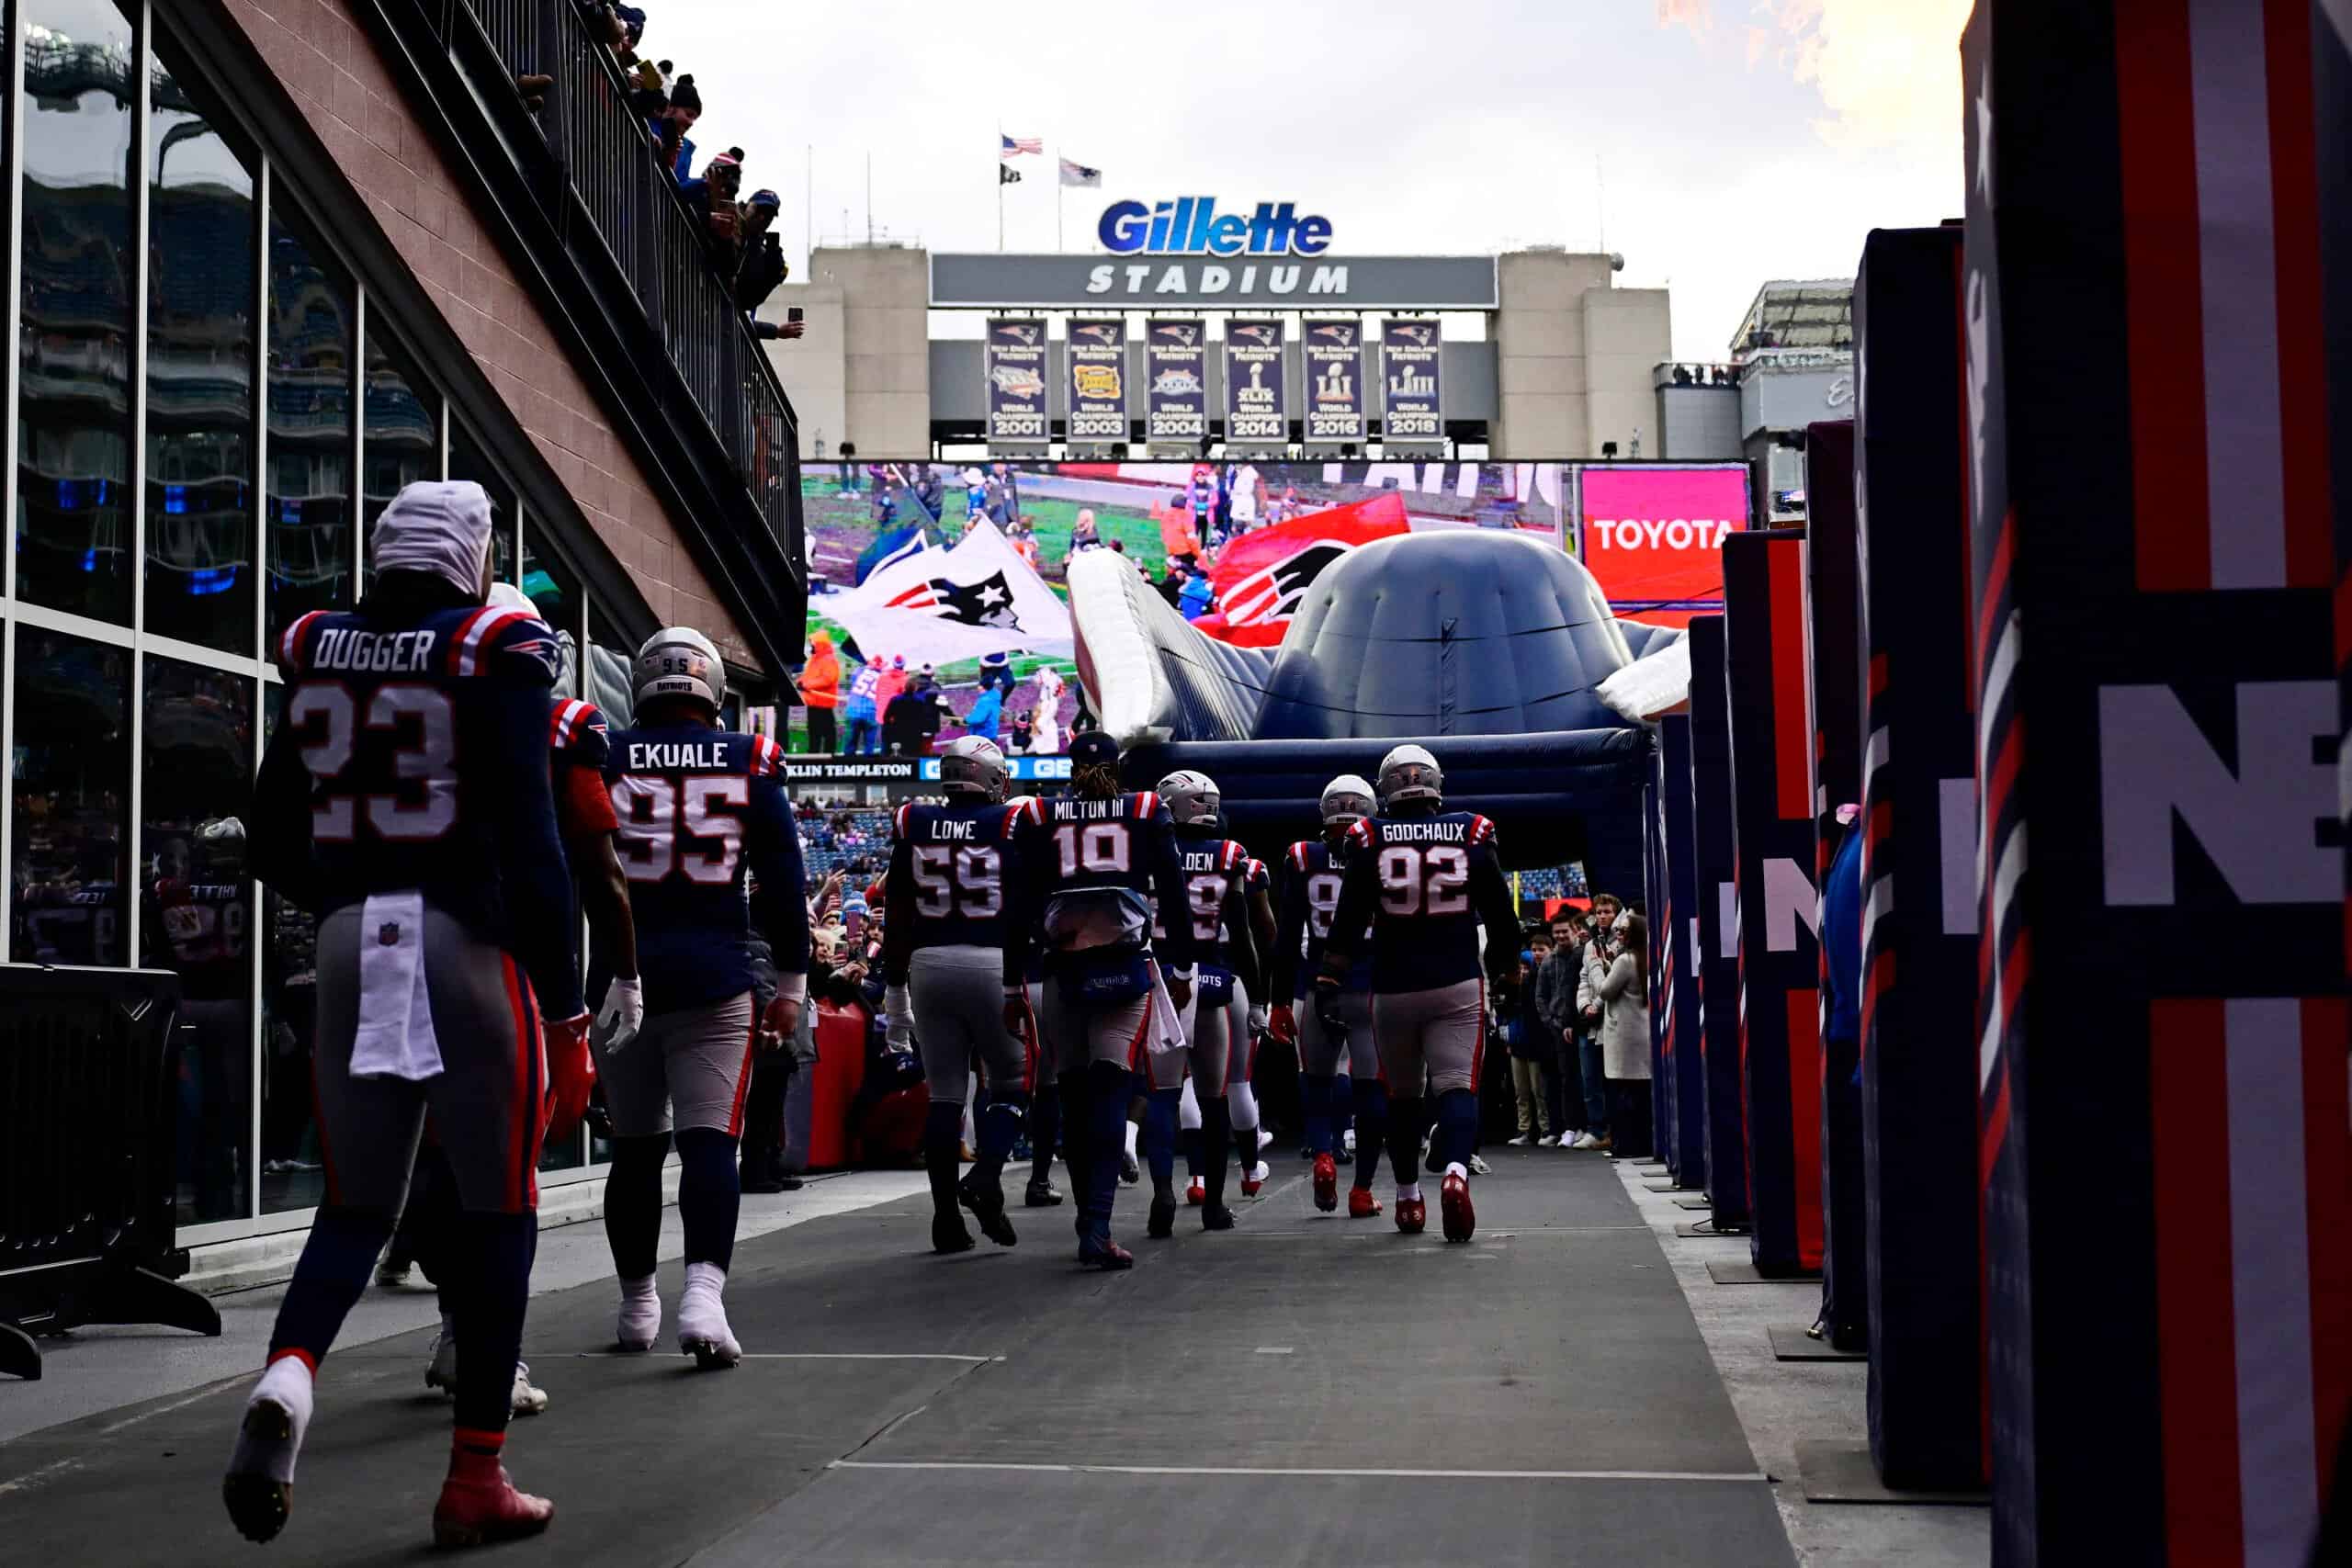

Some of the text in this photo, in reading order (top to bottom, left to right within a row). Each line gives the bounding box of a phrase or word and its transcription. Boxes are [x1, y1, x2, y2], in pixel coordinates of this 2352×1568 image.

[1097, 196, 1334, 258] Gillette
[1086, 265, 1349, 294] STADIUM
[995, 421, 1043, 434] 2001
[1073, 421, 1124, 434] 2003
[1152, 421, 1204, 434] 2004
[1234, 422, 1281, 435] 2014
[1313, 421, 1359, 434] 2016
[1391, 420, 1436, 434] 2018
[1593, 519, 1733, 550] TOYOTA
[313, 628, 436, 671] DUGGER
[288, 682, 458, 840] 23
[628, 742, 729, 769] EKUALE
[824, 764, 911, 777] TEMPLETON
[2098, 679, 2346, 907] NE
[1055, 800, 1106, 820] MILTON
[610, 773, 750, 885] 95
[932, 819, 977, 840] LOWE
[1382, 823, 1465, 842] GODCHAUX
[1182, 852, 1214, 872] DEN
[911, 844, 1003, 919] 59
[1378, 845, 1470, 916] 92
